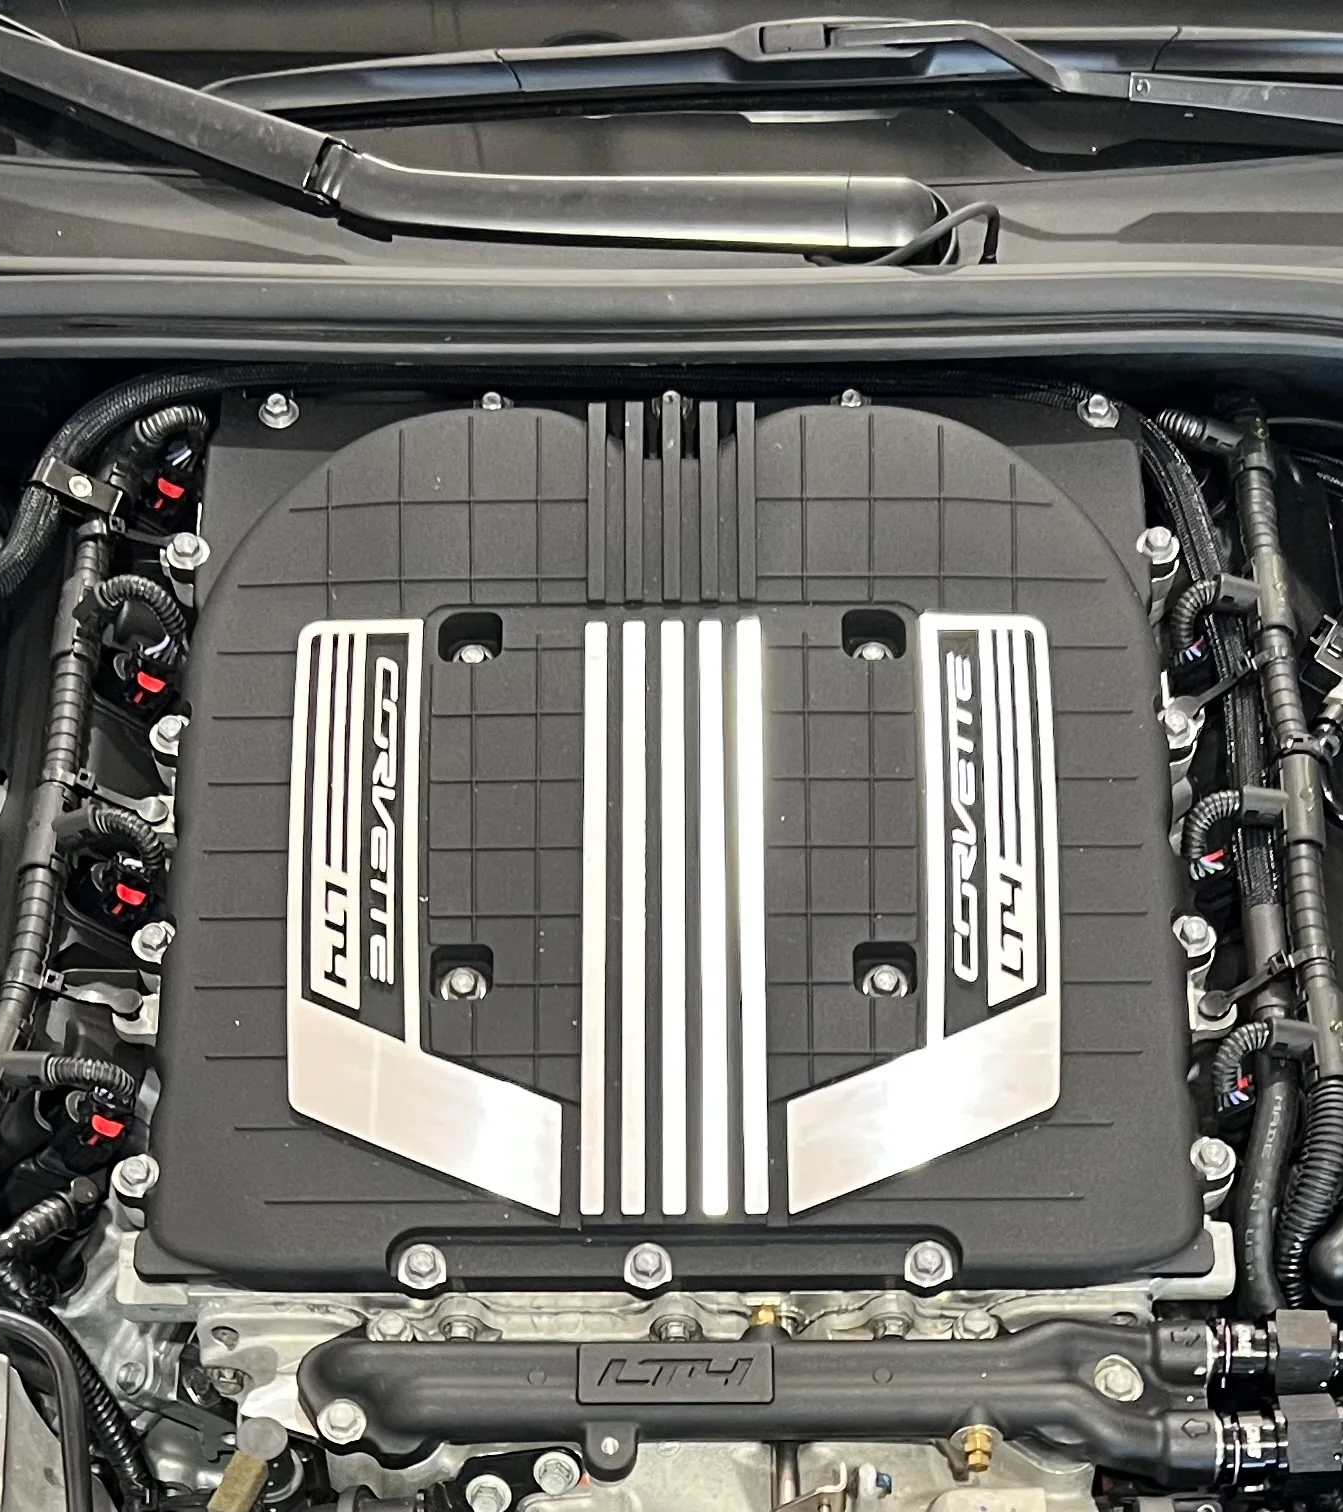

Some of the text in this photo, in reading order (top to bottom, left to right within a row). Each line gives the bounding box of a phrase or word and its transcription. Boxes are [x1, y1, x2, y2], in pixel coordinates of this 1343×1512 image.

[369, 656, 399, 986] CORVETTE
[946, 650, 979, 984] CORVETTE
[324, 879, 348, 988] LT4
[1000, 871, 1025, 981] LT4
[1244, 1095, 1283, 1281] MADE IN USA
[597, 1357, 753, 1386] LT4
